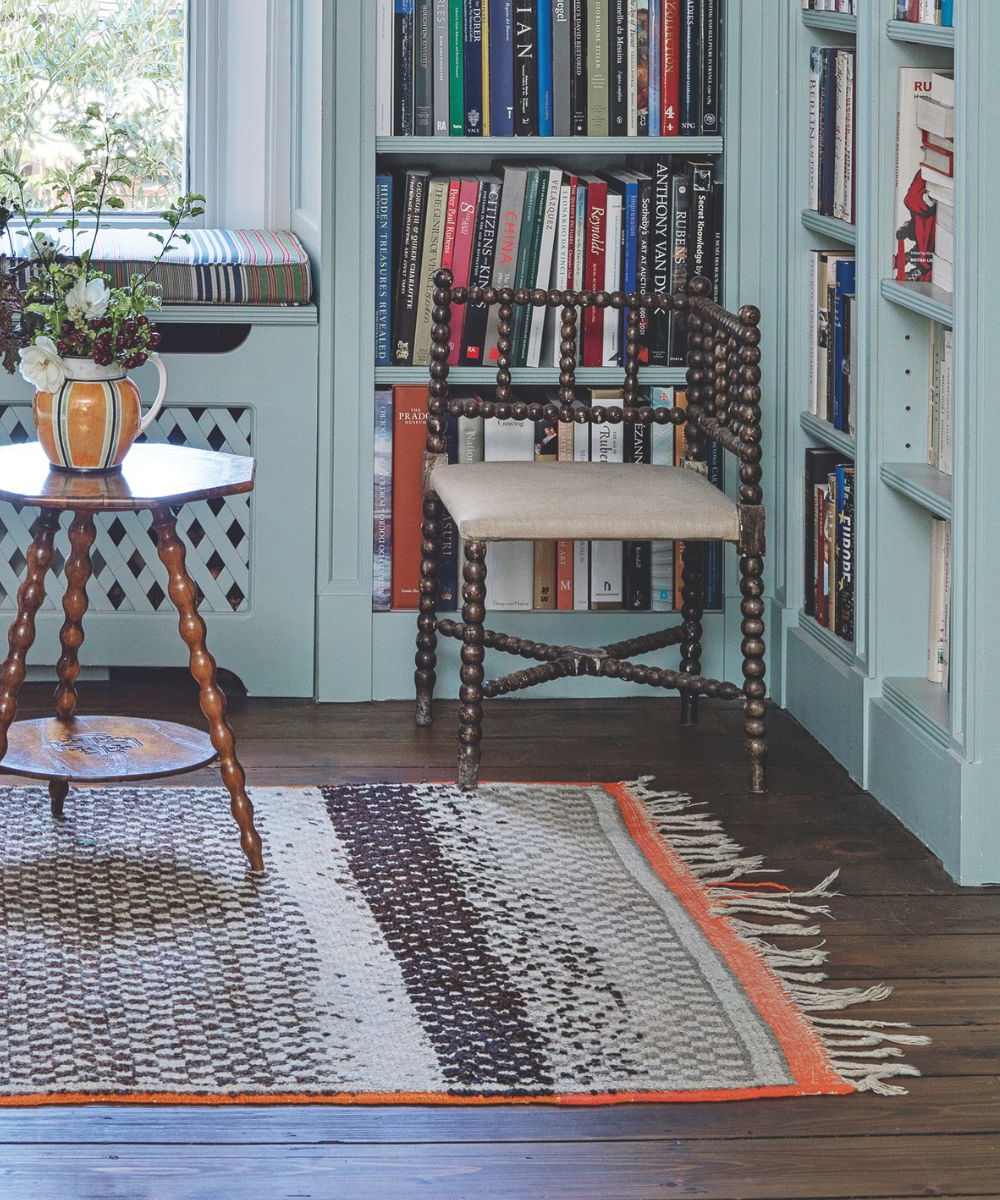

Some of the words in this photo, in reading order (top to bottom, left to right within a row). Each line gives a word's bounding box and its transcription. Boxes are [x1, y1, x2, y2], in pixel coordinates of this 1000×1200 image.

[616, 27, 624, 35] da
[379, 184, 388, 228] HIDDEN
[414, 182, 423, 213] GEORGE
[447, 209, 455, 224] Paul
[449, 189, 458, 206] Peter
[629, 195, 638, 236] Impression
[641, 198, 650, 235] Sotheby's
[655, 163, 668, 237] ANTHONY
[697, 195, 706, 219] Secret
[444, 227, 453, 254] Rubens
[482, 192, 499, 255] CITIZENS
[500, 211, 517, 265] CHINA
[589, 206, 605, 255] Reynolds
[675, 211, 687, 264] RUBENS
[695, 221, 704, 263] Knowledge
[379, 233, 388, 297] TREASURES
[410, 235, 419, 260] QUEEN
[654, 241, 667, 270] VAN
[406, 263, 417, 310] CHARLOTTE
[477, 266, 491, 309] KINS
[694, 265, 703, 275] by
[653, 275, 666, 314] DYK
[378, 302, 387, 359] REVEALED
